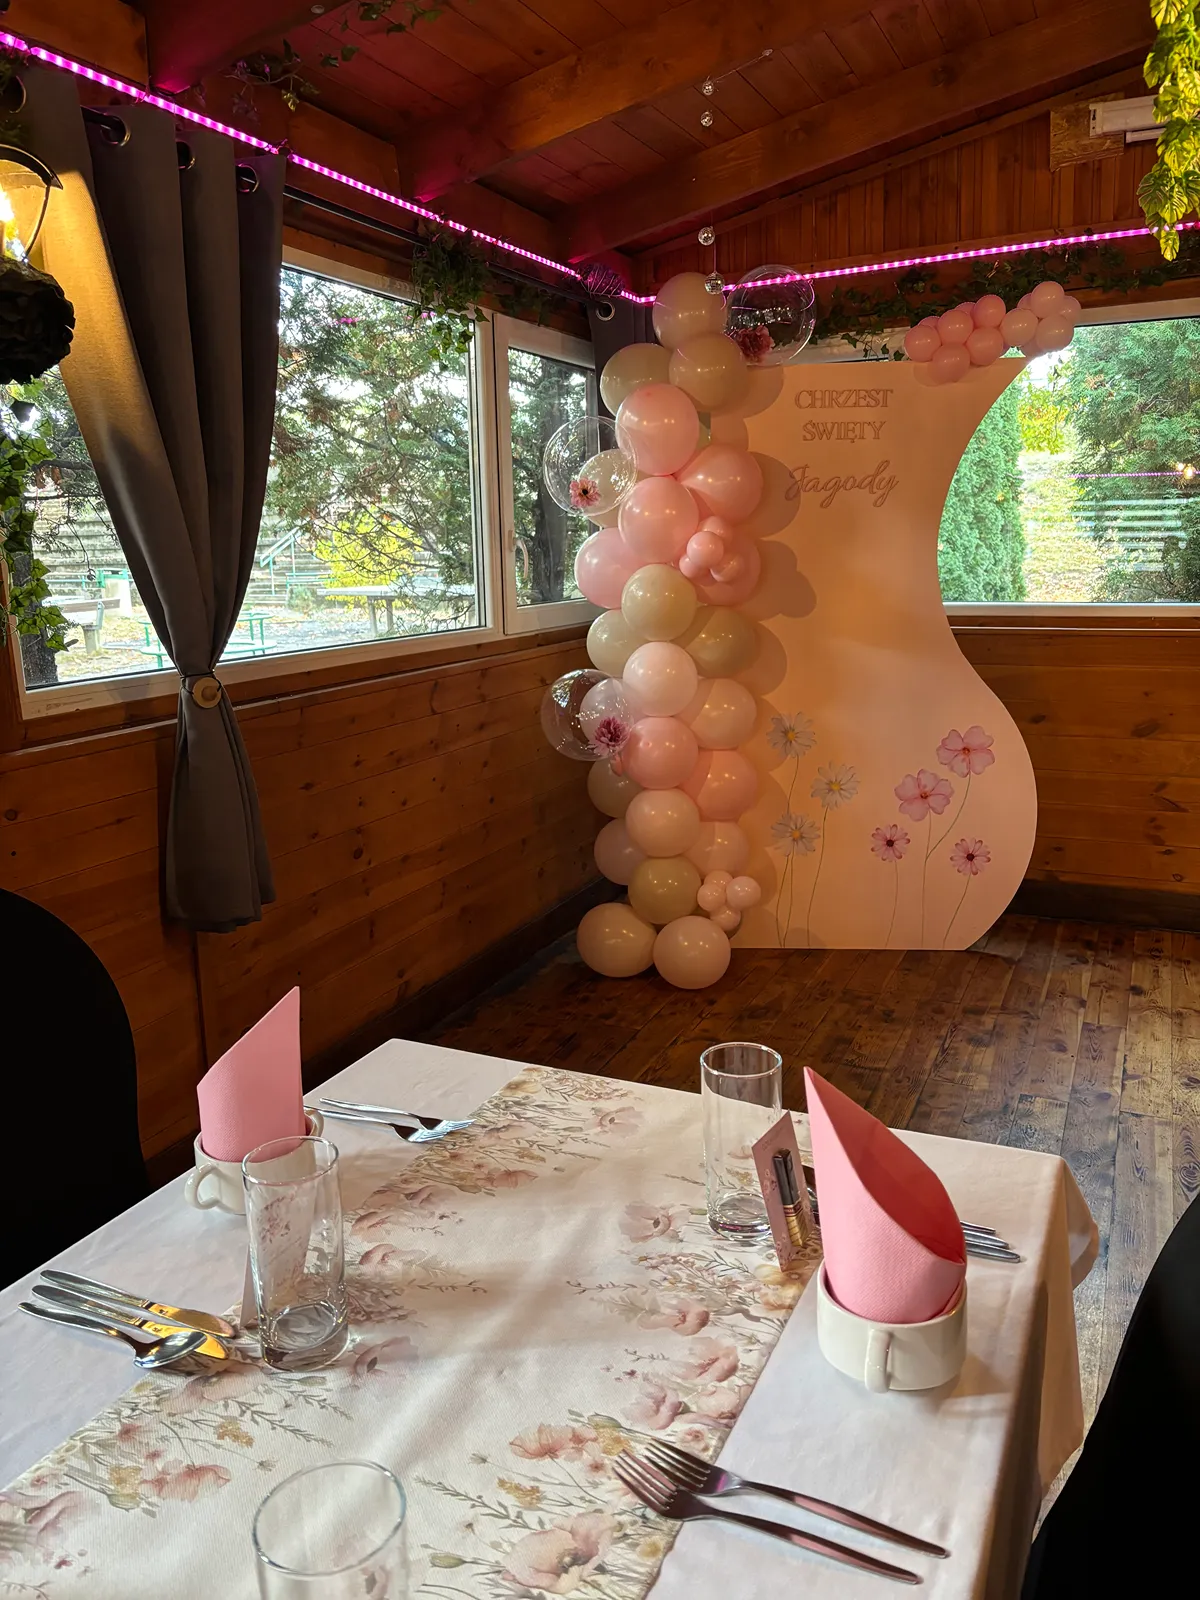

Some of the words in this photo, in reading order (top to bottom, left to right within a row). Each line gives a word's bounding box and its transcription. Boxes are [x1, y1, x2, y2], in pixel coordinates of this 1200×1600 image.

[795, 389, 893, 409] CHRZEST
[802, 419, 887, 443] ŚWIĘTY
[784, 460, 899, 509] Jagody
